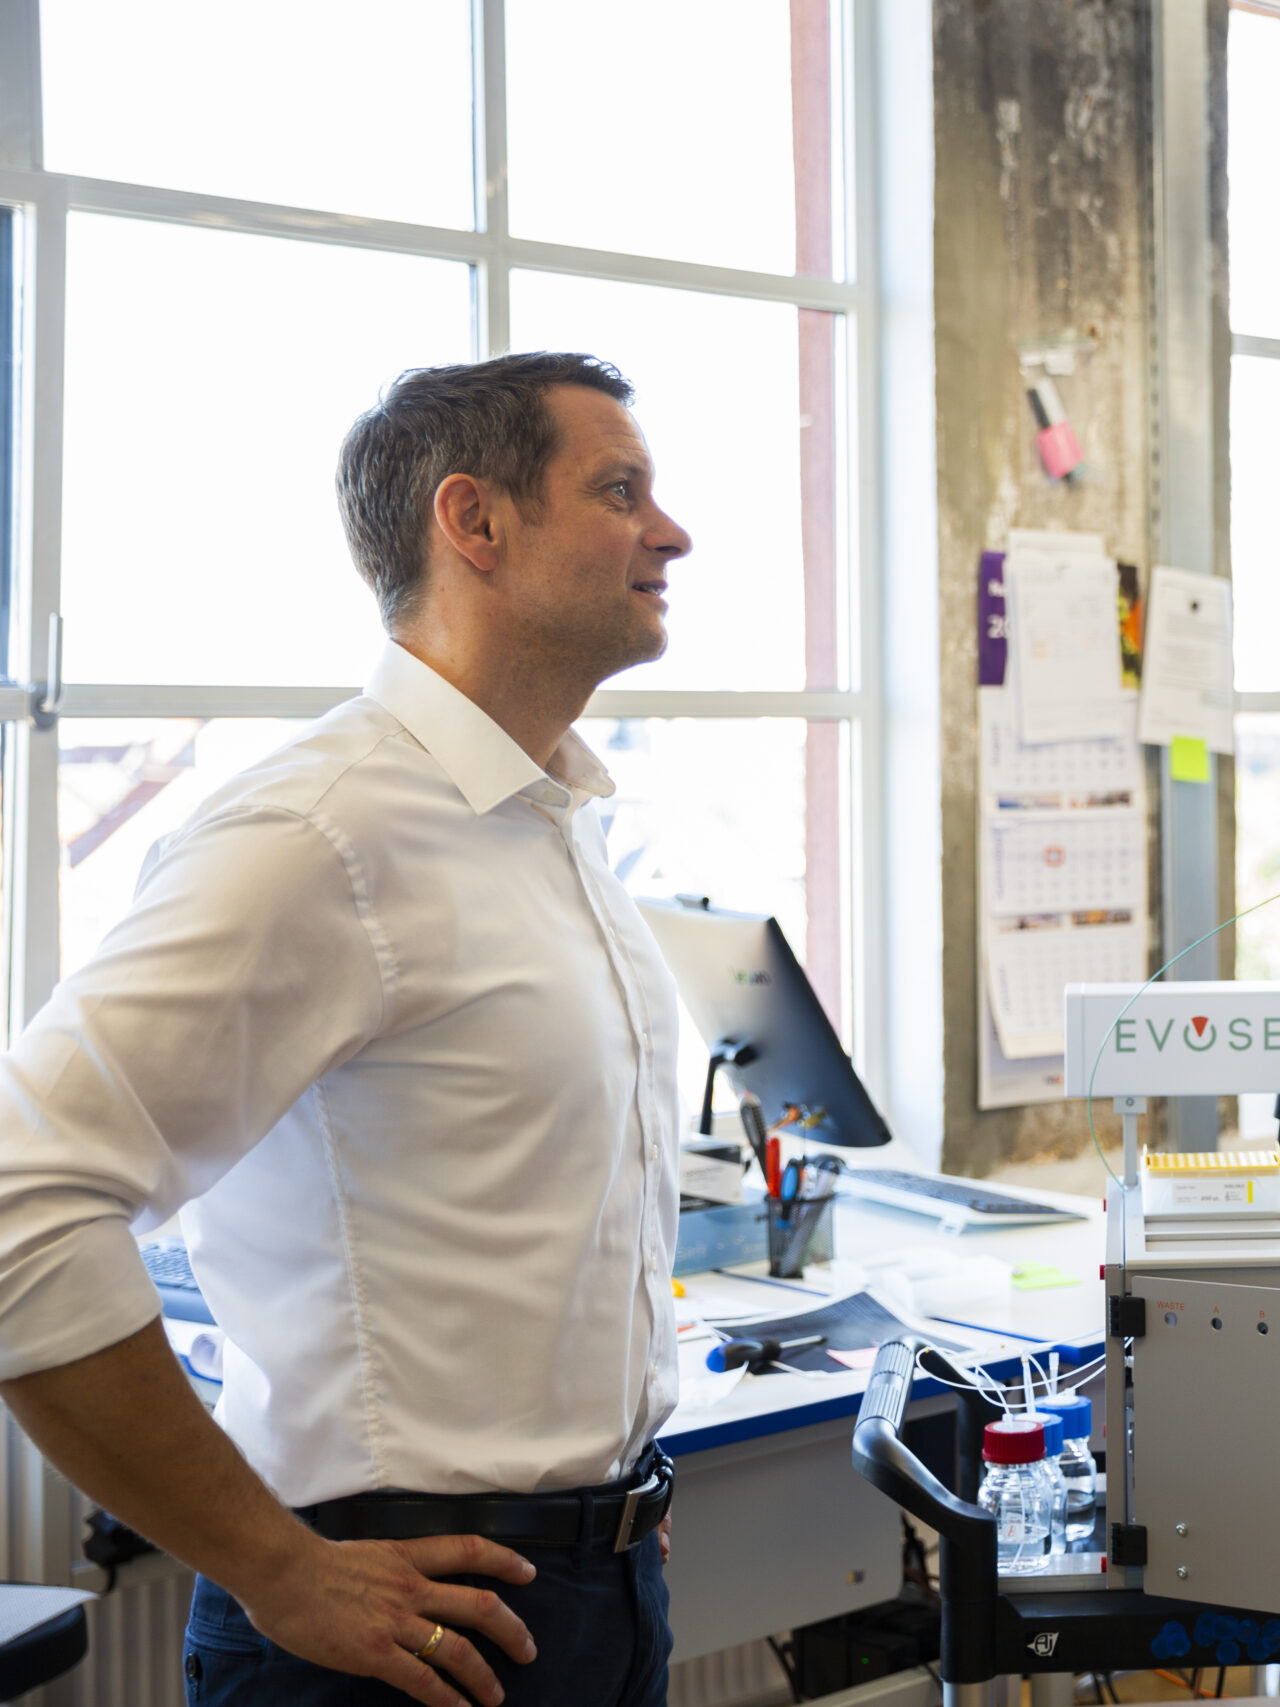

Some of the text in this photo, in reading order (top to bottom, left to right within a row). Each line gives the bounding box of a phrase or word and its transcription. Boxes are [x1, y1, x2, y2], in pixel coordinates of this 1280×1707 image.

[1156, 1301, 1185, 1311] WASTE
[1213, 1306, 1220, 1314] A
[1259, 1310, 1265, 1318] B
